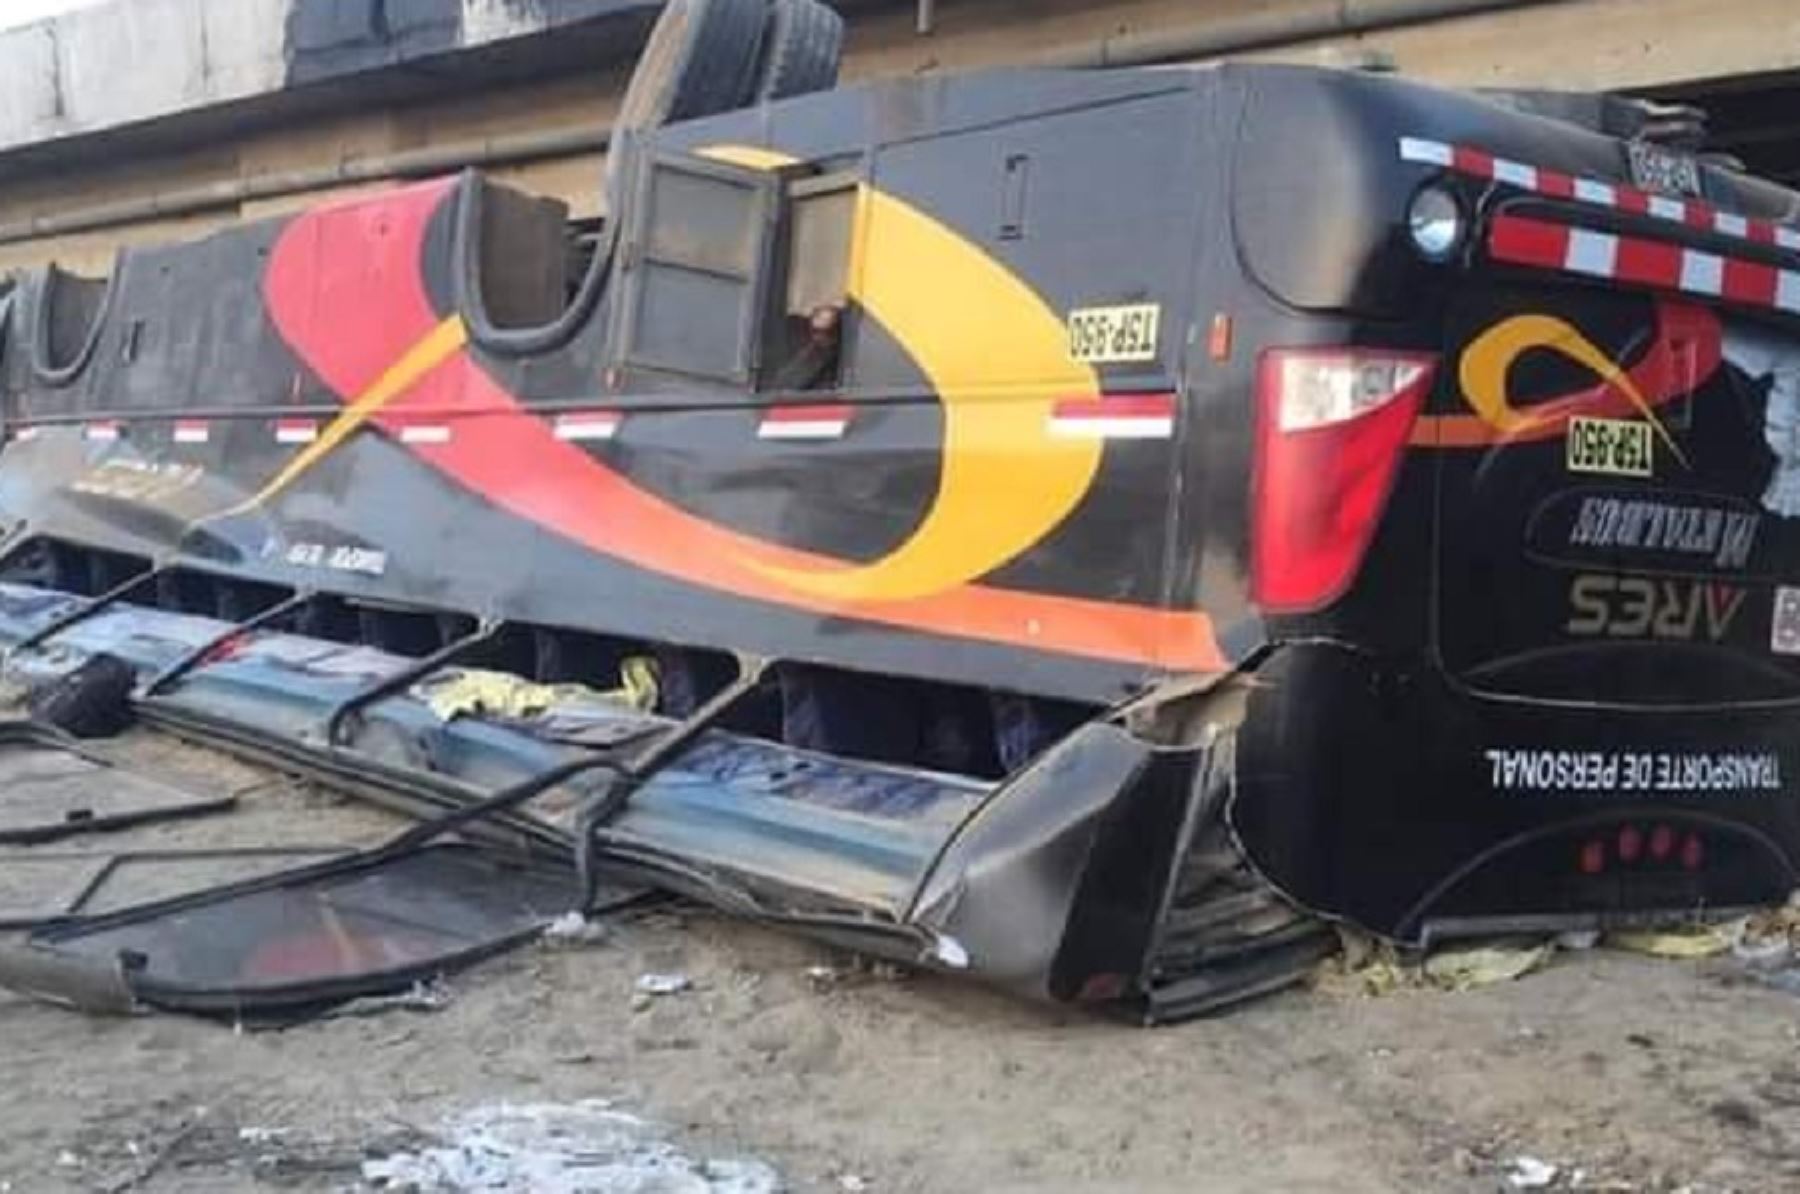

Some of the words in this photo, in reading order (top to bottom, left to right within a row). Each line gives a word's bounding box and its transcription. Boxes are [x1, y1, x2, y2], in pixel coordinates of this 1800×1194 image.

[1571, 420, 1650, 470] TSP-950
[1568, 573, 1746, 638] ARES
[1485, 749, 1619, 789] PERSONAL
[1620, 752, 1651, 790] DE
[1655, 752, 1781, 790] TRANSPORTE
